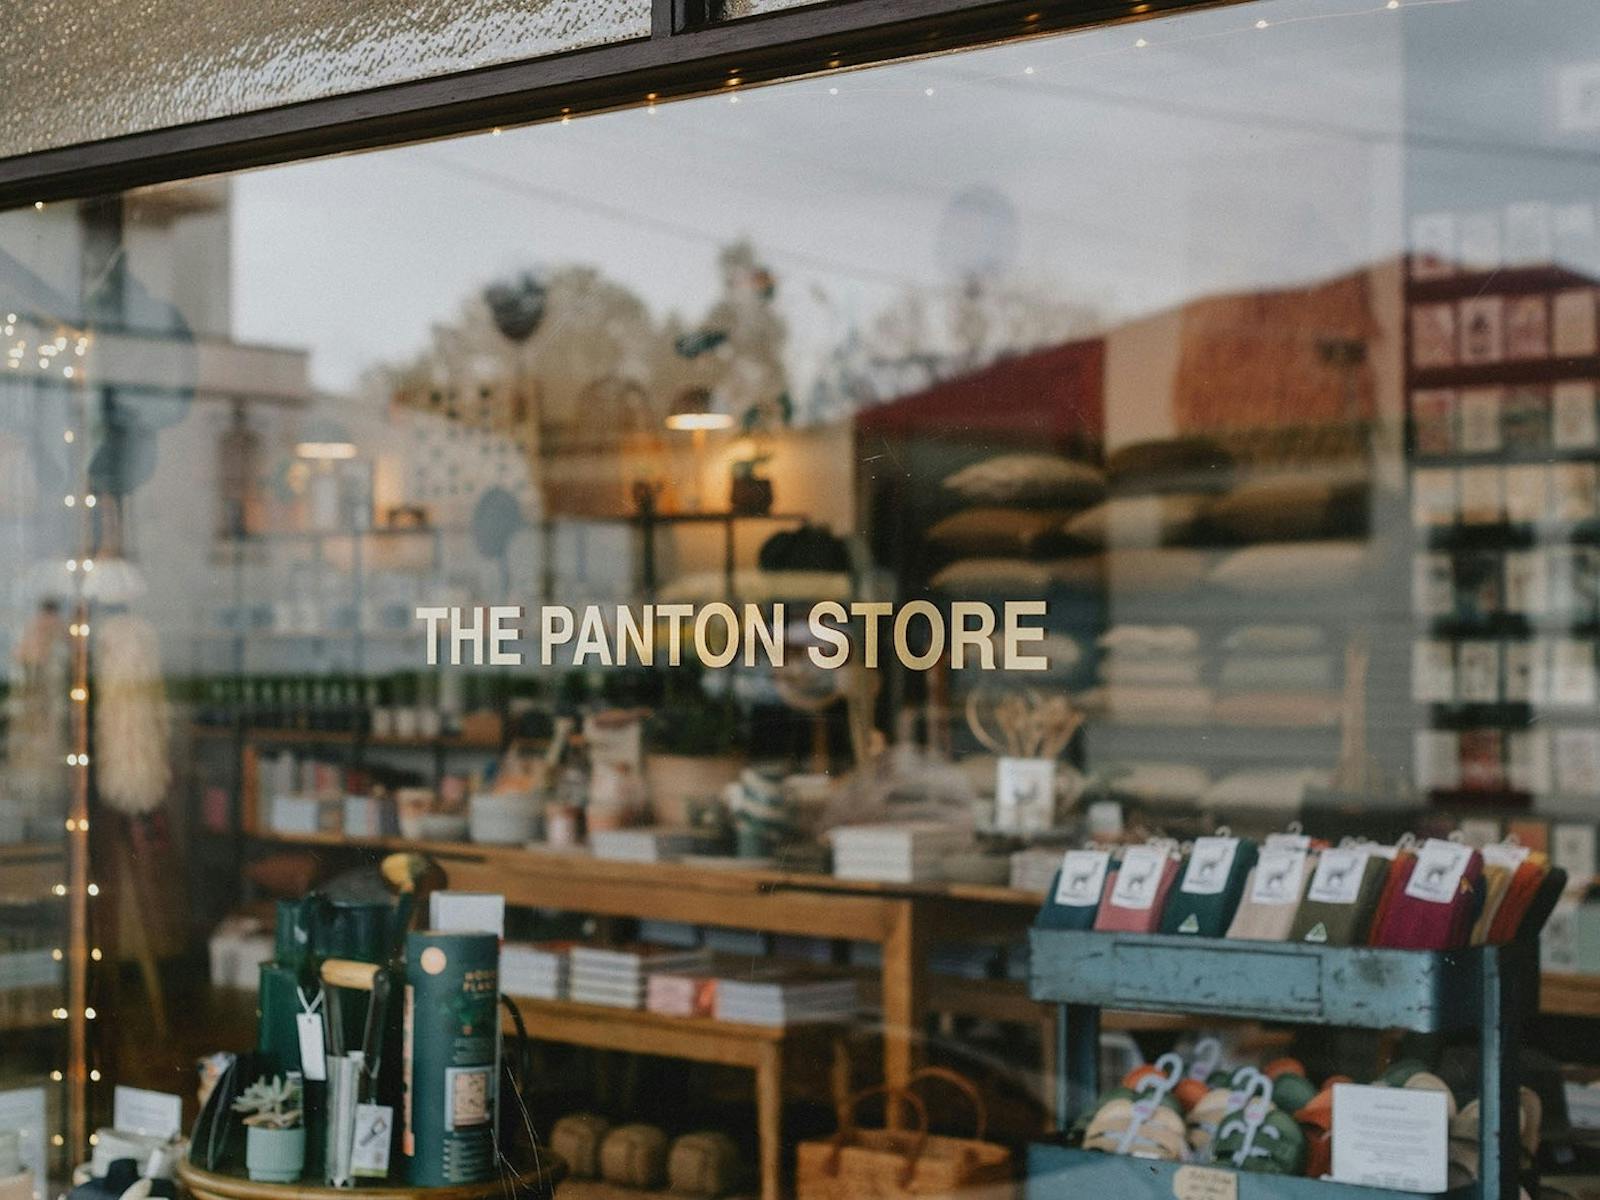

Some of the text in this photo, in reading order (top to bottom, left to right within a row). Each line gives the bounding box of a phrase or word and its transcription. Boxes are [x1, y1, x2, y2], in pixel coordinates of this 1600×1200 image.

[416, 600, 1048, 671] THE PANTON STORE
